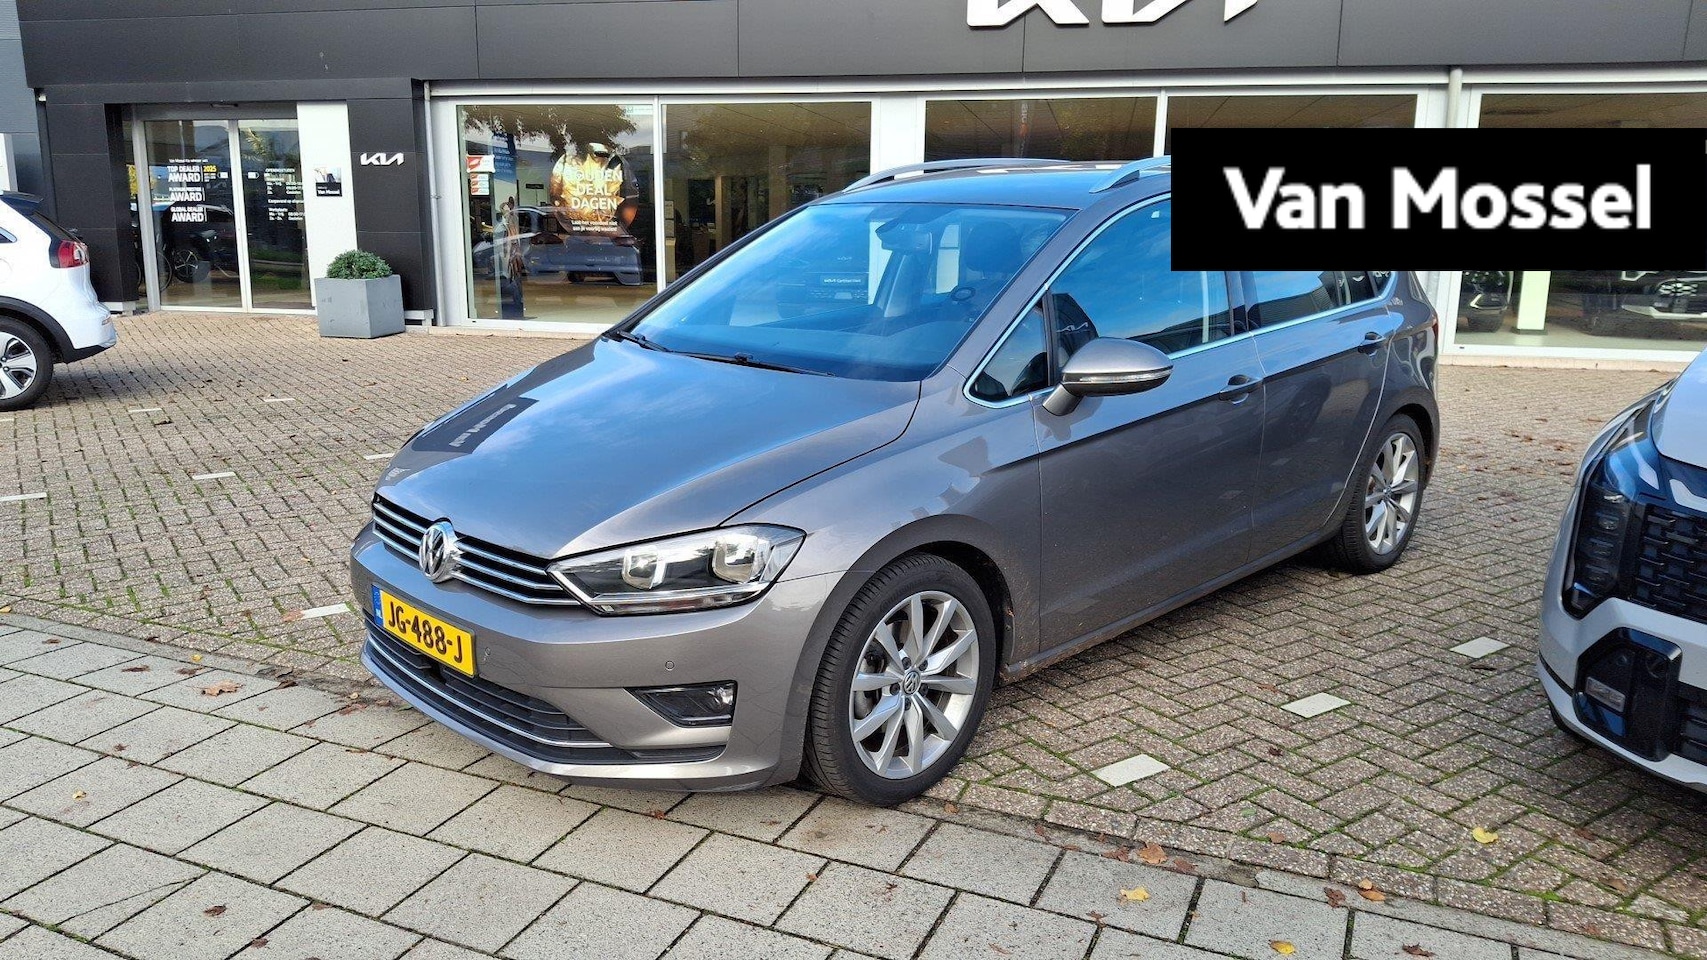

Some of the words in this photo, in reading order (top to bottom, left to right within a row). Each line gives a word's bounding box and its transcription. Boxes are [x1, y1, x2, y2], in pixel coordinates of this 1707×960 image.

[360, 152, 404, 165] KIA
[168, 173, 200, 182] AWARD
[577, 183, 611, 195] DEAL
[170, 192, 202, 201] AWARD
[571, 197, 618, 209] DAGEN
[171, 213, 204, 222] AWARD
[388, 601, 463, 663] JG-488-J
